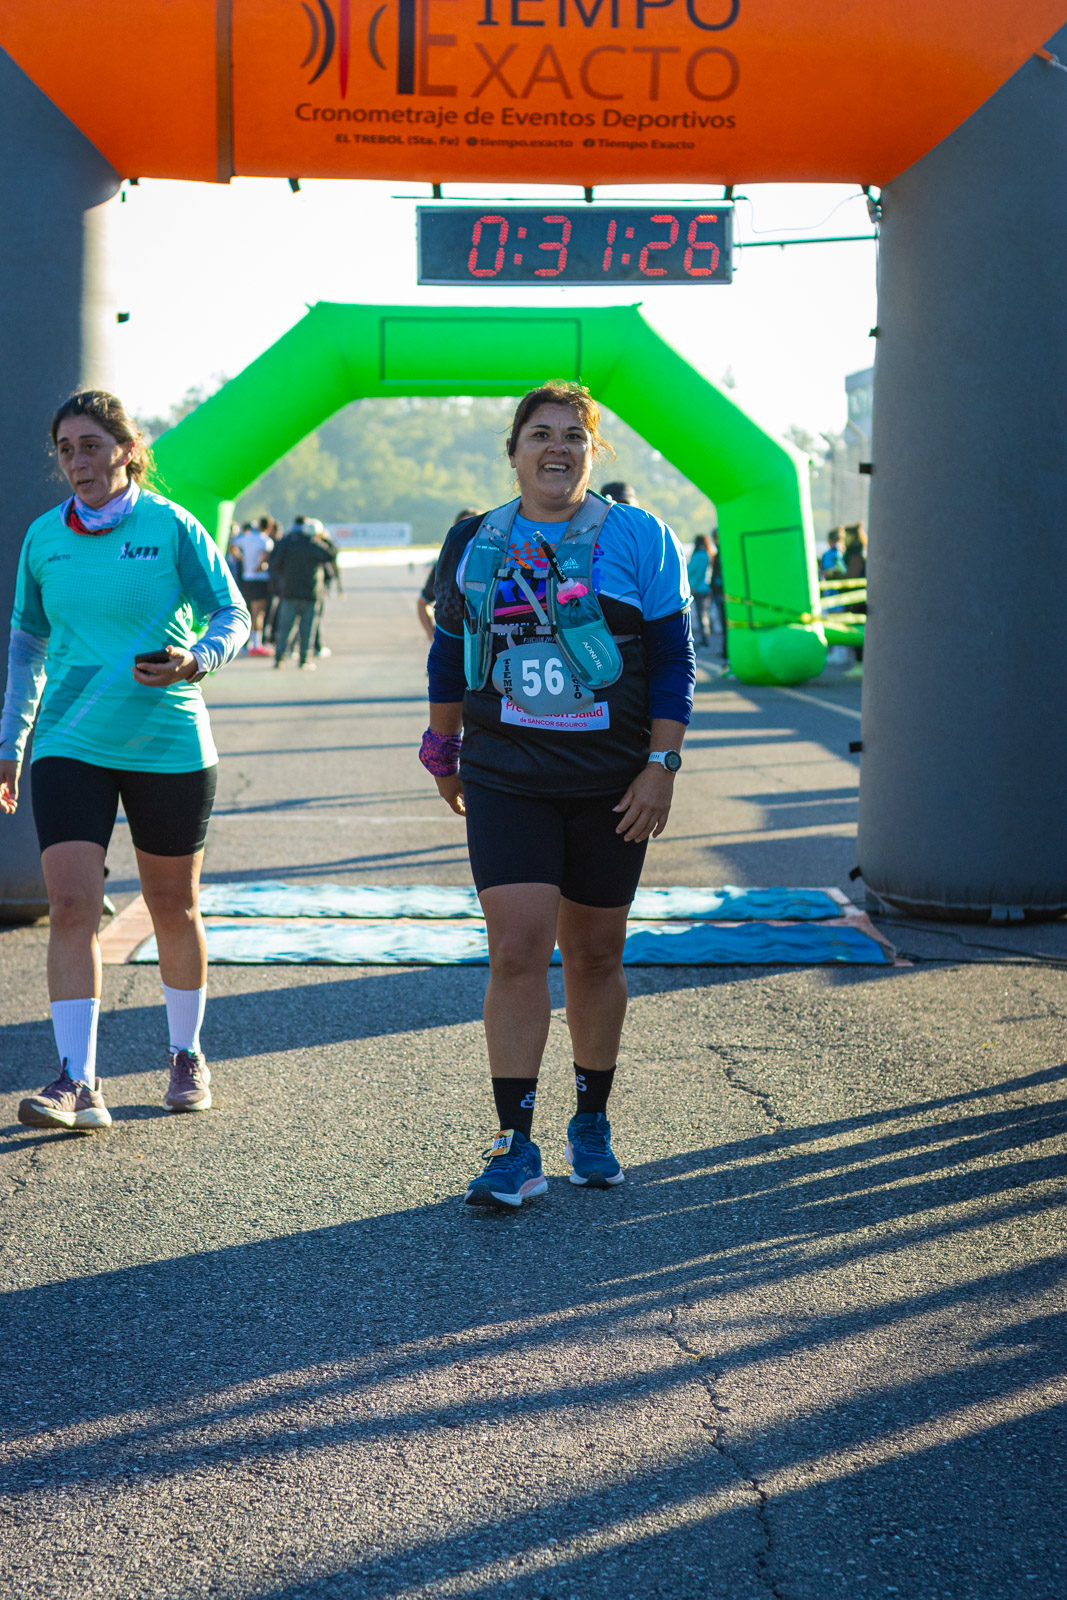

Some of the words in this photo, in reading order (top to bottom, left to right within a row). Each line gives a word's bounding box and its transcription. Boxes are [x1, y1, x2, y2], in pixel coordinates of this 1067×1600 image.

[418, 0, 740, 101] EXACTO
[295, 103, 459, 128] Cronometraje
[464, 106, 494, 125] de
[501, 107, 596, 127] Eventos
[602, 109, 737, 131] Deportivos
[335, 133, 351, 143] EL
[353, 133, 405, 145] TREBOL
[407, 135, 437, 146] (Sta.
[440, 136, 460, 147] Fe)
[598, 138, 649, 150] Tiempo
[651, 140, 696, 150] Exacto
[120, 542, 160, 559] km
[582, 641, 604, 671] AONIJIE
[503, 658, 514, 701] TIEMPO
[521, 657, 565, 697] 56
[527, 718, 555, 727] SANCOR
